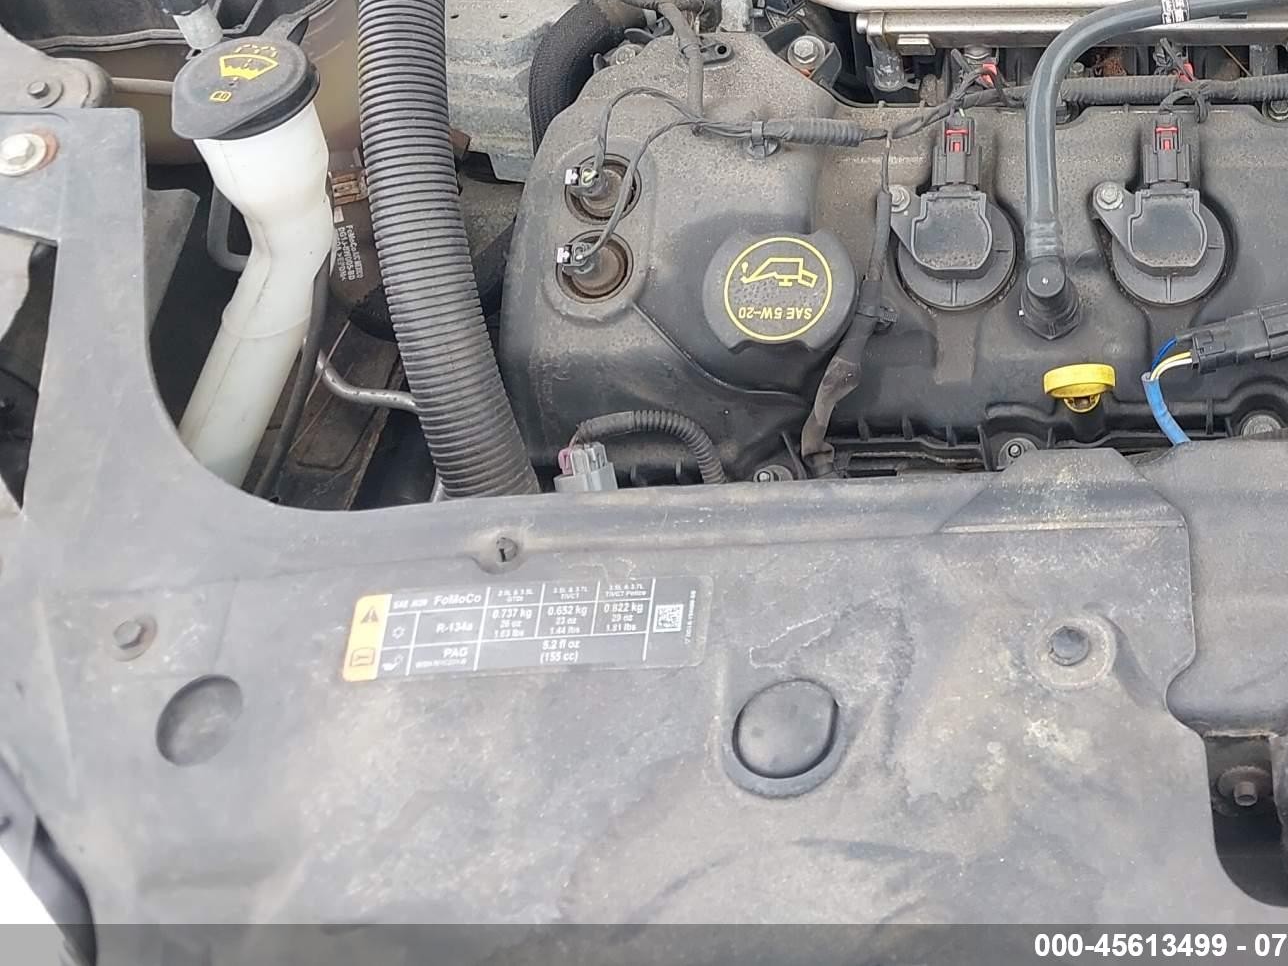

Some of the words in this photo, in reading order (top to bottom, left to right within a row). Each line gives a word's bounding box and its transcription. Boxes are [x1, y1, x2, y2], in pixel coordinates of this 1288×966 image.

[738, 307, 783, 320] 5W-20
[785, 307, 812, 320] SAE
[433, 593, 482, 606] FoMoCo
[547, 605, 574, 616] 0.652
[575, 605, 588, 616] kg
[631, 602, 644, 613] kg
[492, 608, 518, 619] 0.737
[519, 608, 533, 620] kg
[624, 623, 637, 631] lbs
[567, 640, 580, 649] oz
[443, 646, 469, 658] PAG
[540, 651, 562, 665] (155
[563, 650, 579, 663] cc)
